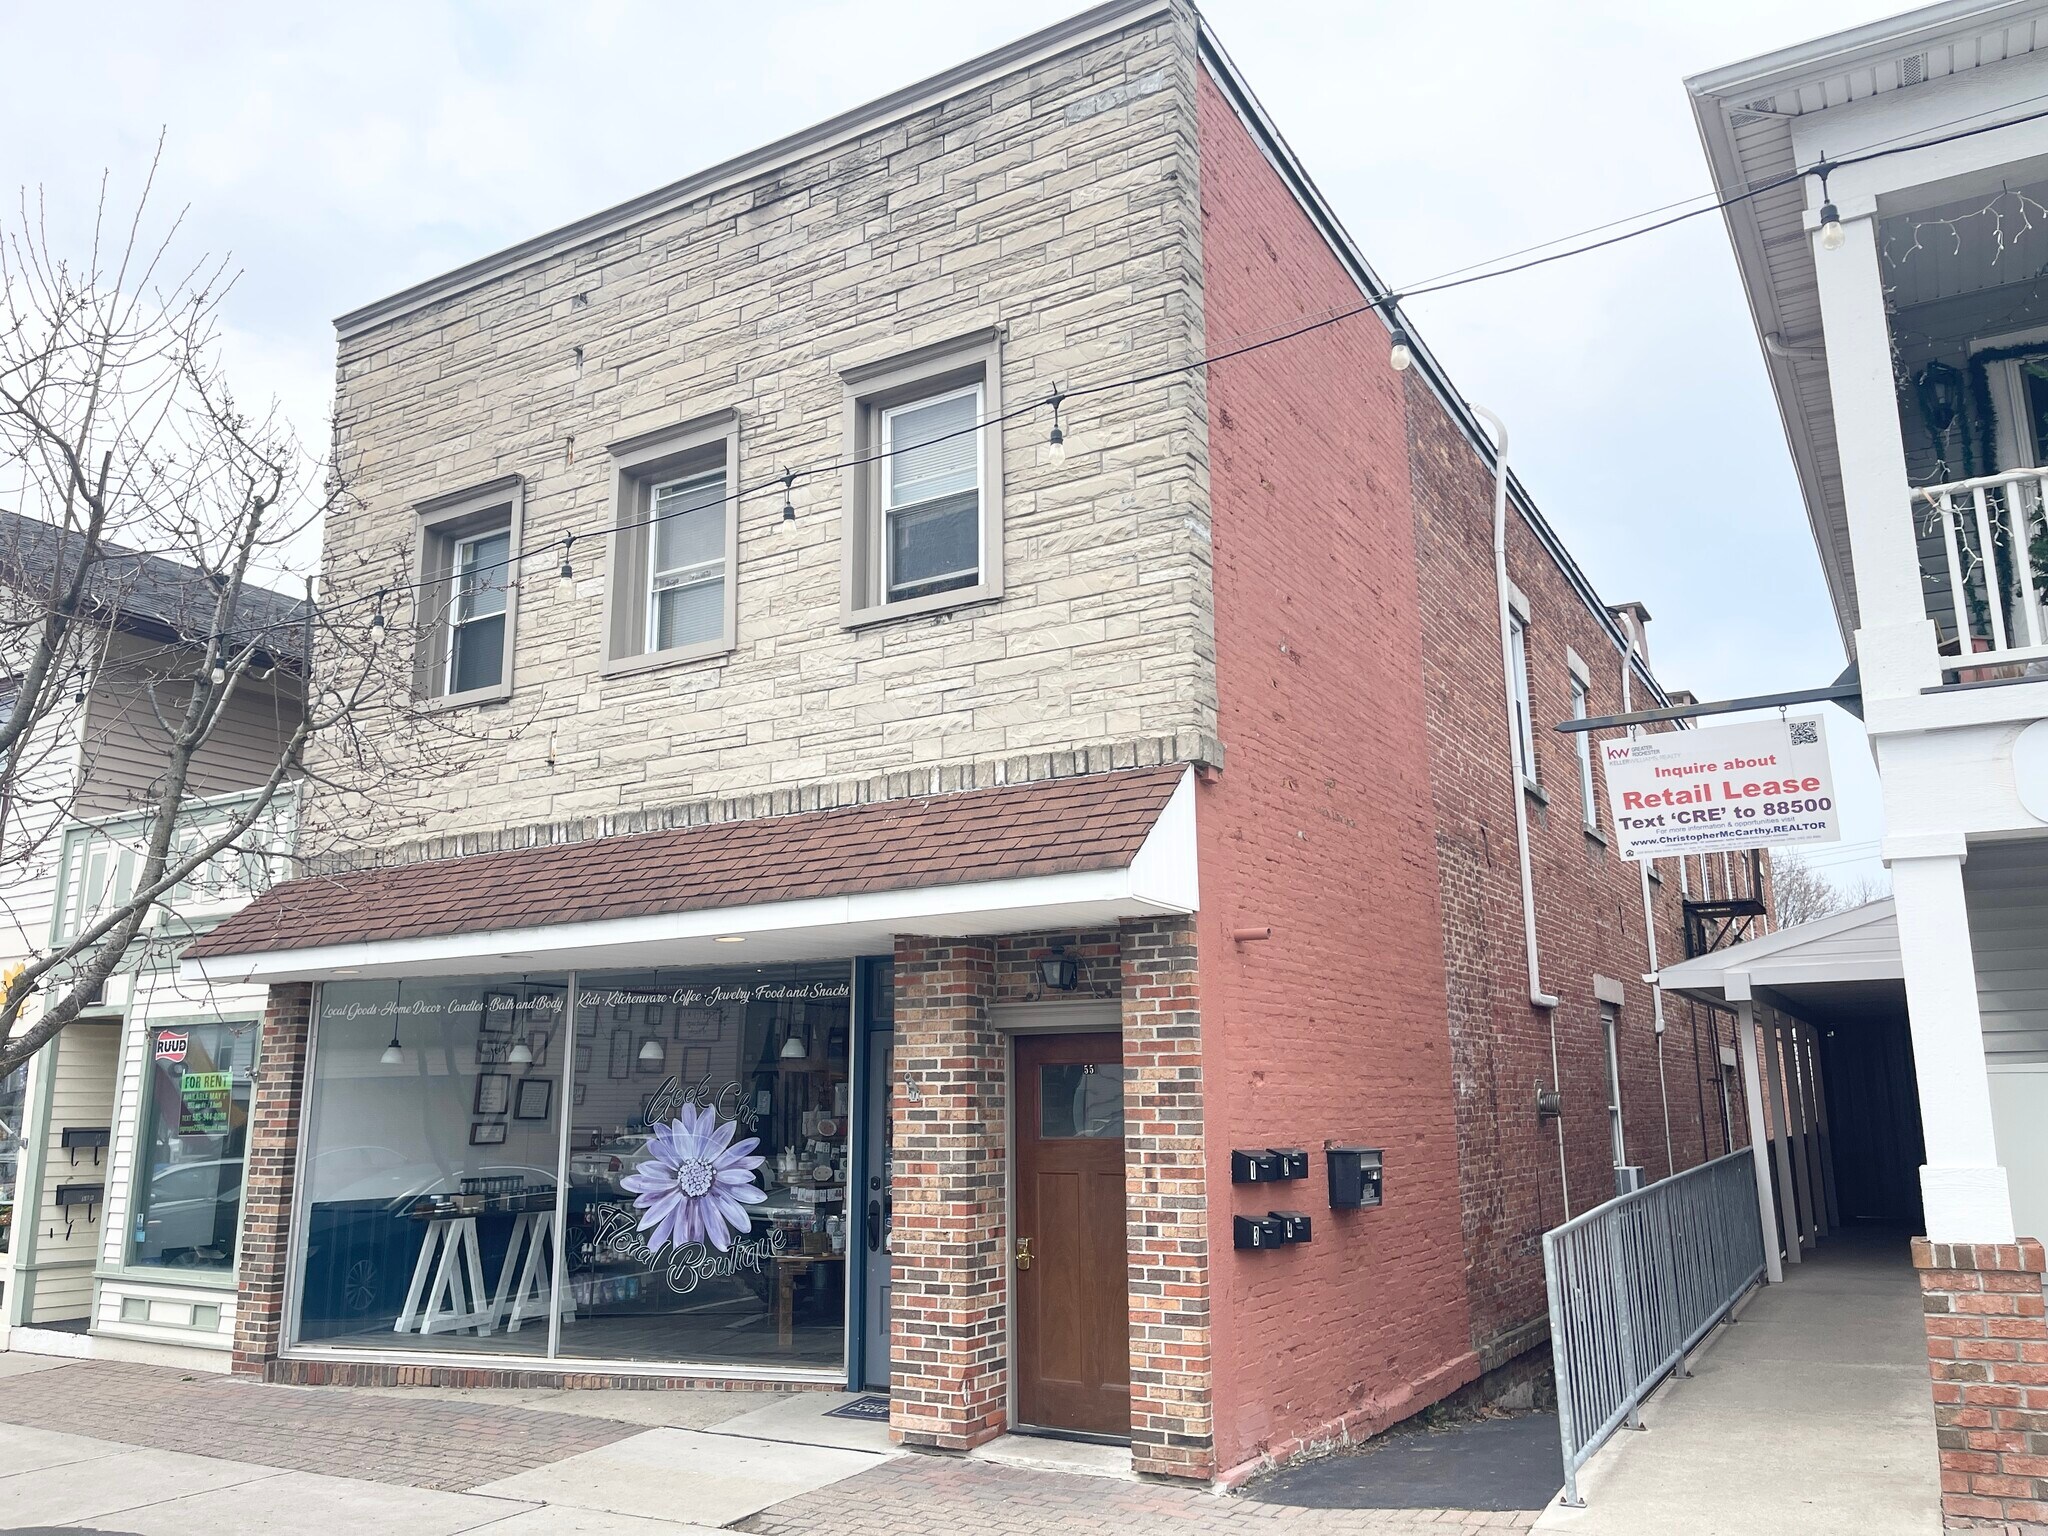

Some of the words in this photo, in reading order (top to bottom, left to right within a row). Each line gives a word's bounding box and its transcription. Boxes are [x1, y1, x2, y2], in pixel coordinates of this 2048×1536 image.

[1607, 746, 1629, 759] kw
[1655, 763, 1717, 778] Inquire
[1723, 754, 1777, 771] about
[1622, 783, 1712, 811] Retail
[1722, 777, 1820, 800] Lease
[1619, 814, 1666, 830] Text
[1733, 806, 1756, 819] to
[1763, 797, 1832, 816] 88500
[1655, 827, 1667, 835] For
[1669, 826, 1686, 834] more
[1688, 822, 1725, 832] information
[1734, 816, 1780, 828] opportunities
[1630, 821, 1826, 847] www.ChristopherMcCarthy.REALTOR
[321, 1003, 348, 1018] Local
[346, 1002, 378, 1021] Goods
[380, 1001, 412, 1016] Home
[412, 1000, 441, 1015] Decor
[447, 999, 483, 1014] Candles
[489, 996, 516, 1012] Bath
[515, 998, 537, 1010] and
[535, 995, 564, 1014] Body
[576, 992, 601, 1008] Kids
[604, 990, 668, 1007] Kitchenware
[672, 988, 702, 1006] Coffee
[705, 986, 750, 1007] Jewelry
[755, 984, 787, 1000] Food
[786, 984, 809, 998] and
[809, 982, 850, 999] Snacks
[157, 1040, 187, 1054] RUUD
[185, 1075, 202, 1089] FOR
[204, 1074, 229, 1088] RENT
[1083, 1064, 1095, 1075] 55
[643, 1073, 713, 1127] Geek
[714, 1080, 760, 1133] Chic
[592, 1204, 672, 1273] Floral
[665, 1227, 788, 1294] Boutique
